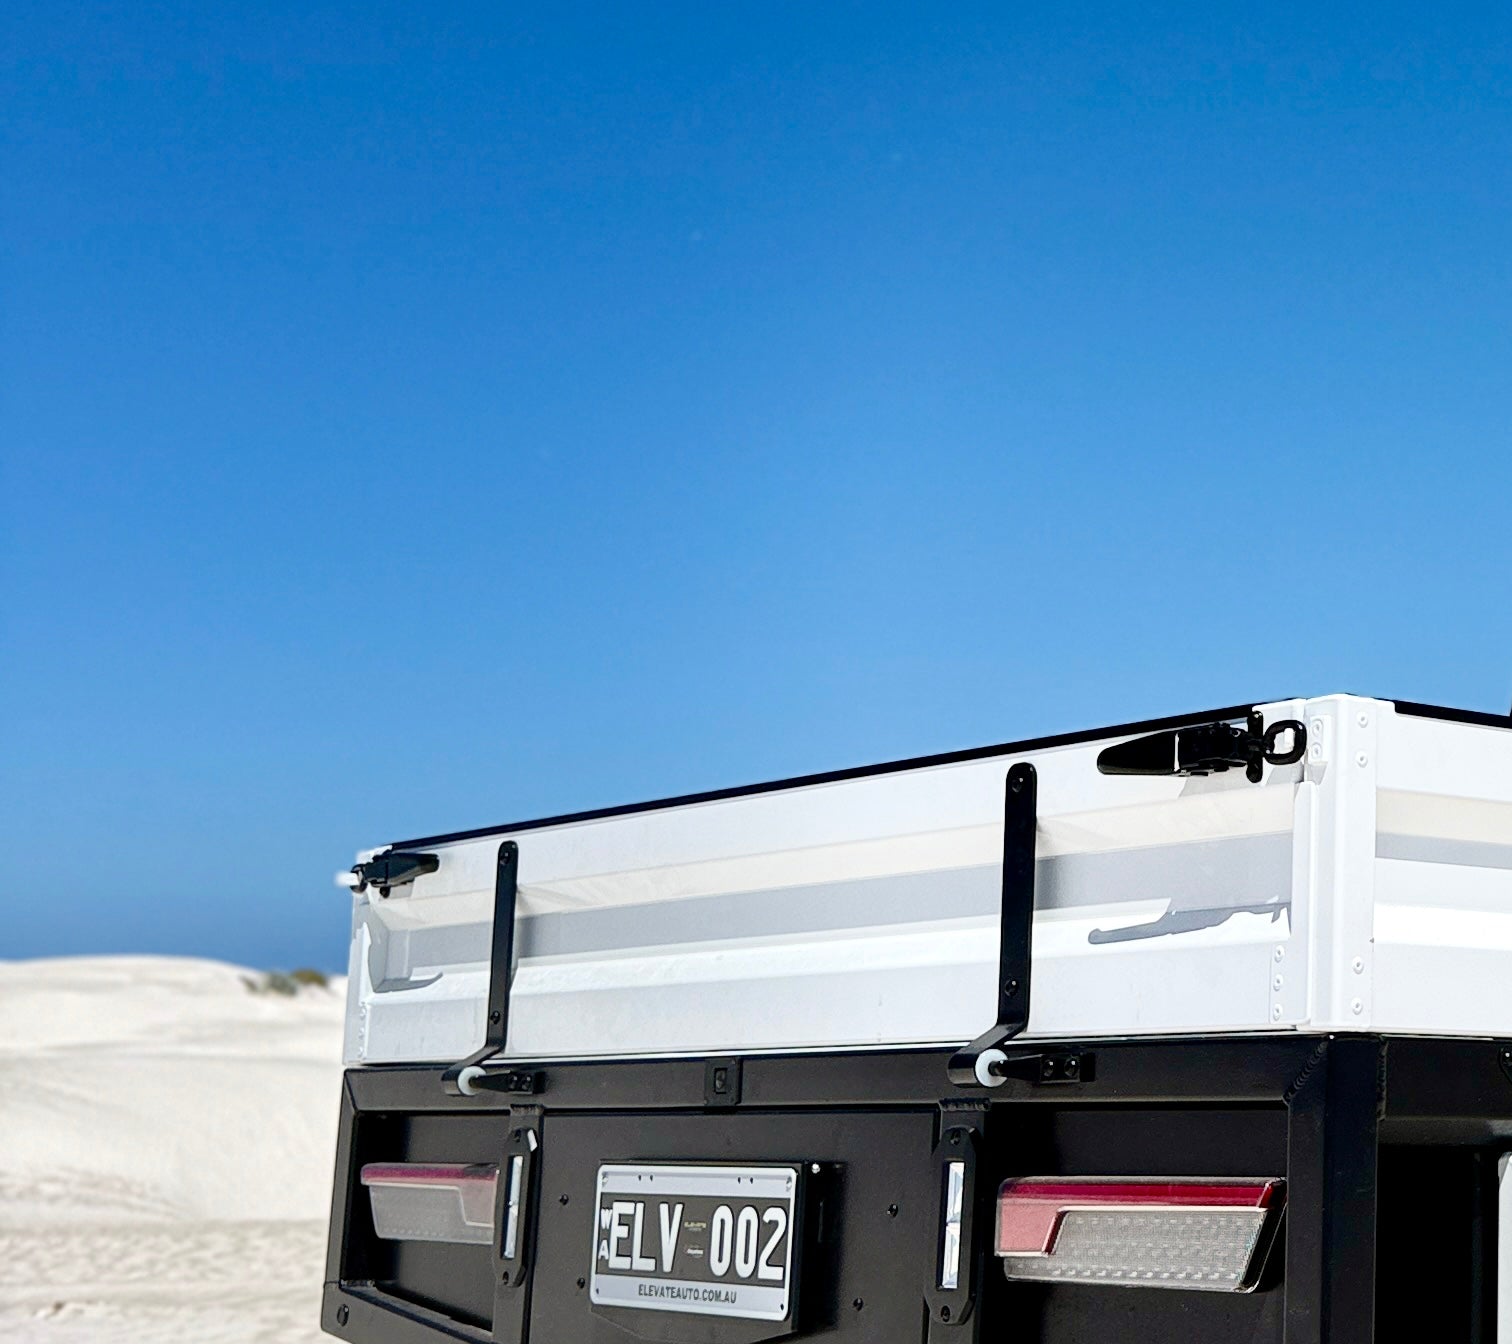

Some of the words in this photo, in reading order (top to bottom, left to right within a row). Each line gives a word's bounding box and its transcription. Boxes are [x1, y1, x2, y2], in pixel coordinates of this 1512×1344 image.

[609, 1201, 683, 1273] ELV
[710, 1204, 787, 1281] 002
[638, 1284, 737, 1303] ELEVATEAUTO.COM.AU
